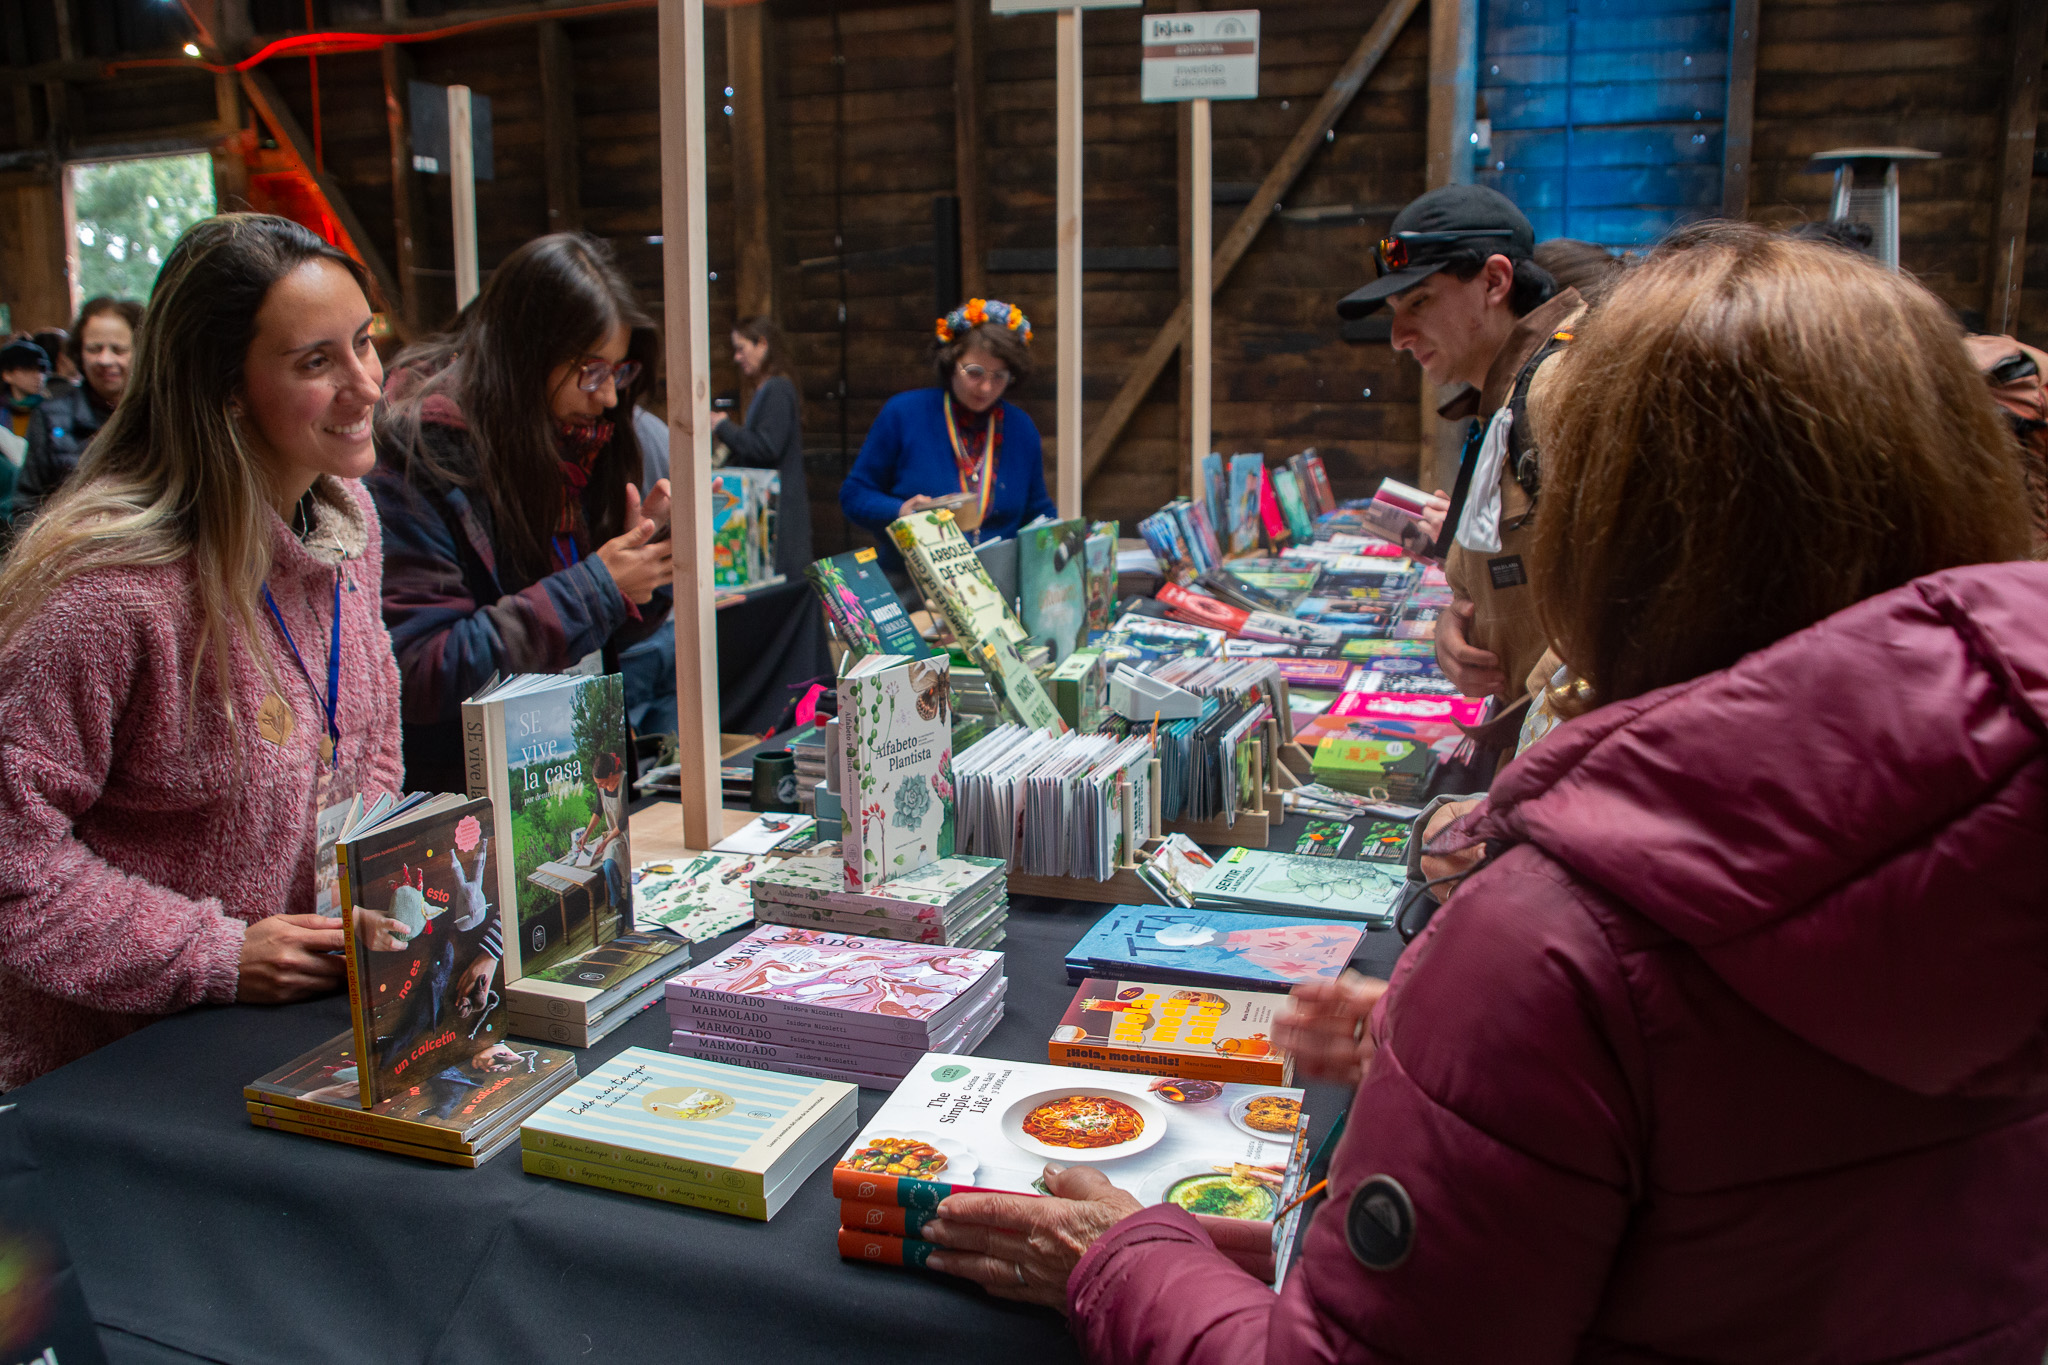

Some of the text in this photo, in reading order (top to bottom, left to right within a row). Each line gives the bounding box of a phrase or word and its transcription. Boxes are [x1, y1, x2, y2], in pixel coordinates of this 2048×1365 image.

[929, 542, 973, 564] ÁRBOLES
[939, 559, 982, 580] DE CHILE
[467, 722, 483, 742] SE
[519, 710, 542, 737] SE
[845, 711, 853, 740] Alfabeto
[521, 739, 558, 763] vive
[875, 736, 918, 760] Alfabeto
[469, 749, 484, 781] vive
[889, 749, 932, 772] Plantista
[523, 760, 582, 792] la casa
[1215, 869, 1242, 891] SENTIR
[426, 887, 450, 903] esto
[778, 889, 804, 899] Alfabeto
[345, 930, 352, 940] no
[346, 944, 353, 955] es
[715, 935, 864, 970] MARMOLADO
[348, 957, 354, 968] un
[349, 970, 359, 1005] calcetín
[399, 959, 421, 999] no es
[689, 988, 844, 1018] MARMOLADO Isidora Nicoletti
[692, 1004, 847, 1033] MARMOLADO Isidora Nicoletti
[696, 1020, 850, 1050] MARMOLADO Isidora Nicoletti
[394, 1030, 456, 1075] un calcetín
[699, 1038, 858, 1065] MARMOLADO Isidora Nicoletti
[1066, 1048, 1106, 1060] ¡Hola,
[1109, 1052, 1180, 1067] mocktails!
[693, 1051, 848, 1081] MARMOLADO Isidora Nicoletti
[471, 1077, 514, 1104] calcetín
[566, 1100, 595, 1115] Todo
[610, 1064, 646, 1085] tiempo
[962, 1075, 980, 1091] Cocina
[295, 1101, 310, 1111] esto
[312, 1105, 322, 1113] no
[333, 1109, 343, 1117] un
[344, 1110, 374, 1123] calcetín
[927, 1092, 951, 1109] The
[940, 1094, 971, 1124] Simple
[299, 1113, 380, 1135] esto no es un calcetín
[303, 1127, 384, 1148] esto no es un calcetín
[552, 1138, 568, 1149] Todo
[582, 1144, 609, 1159] tiempo
[625, 1155, 660, 1168] Anastasia
